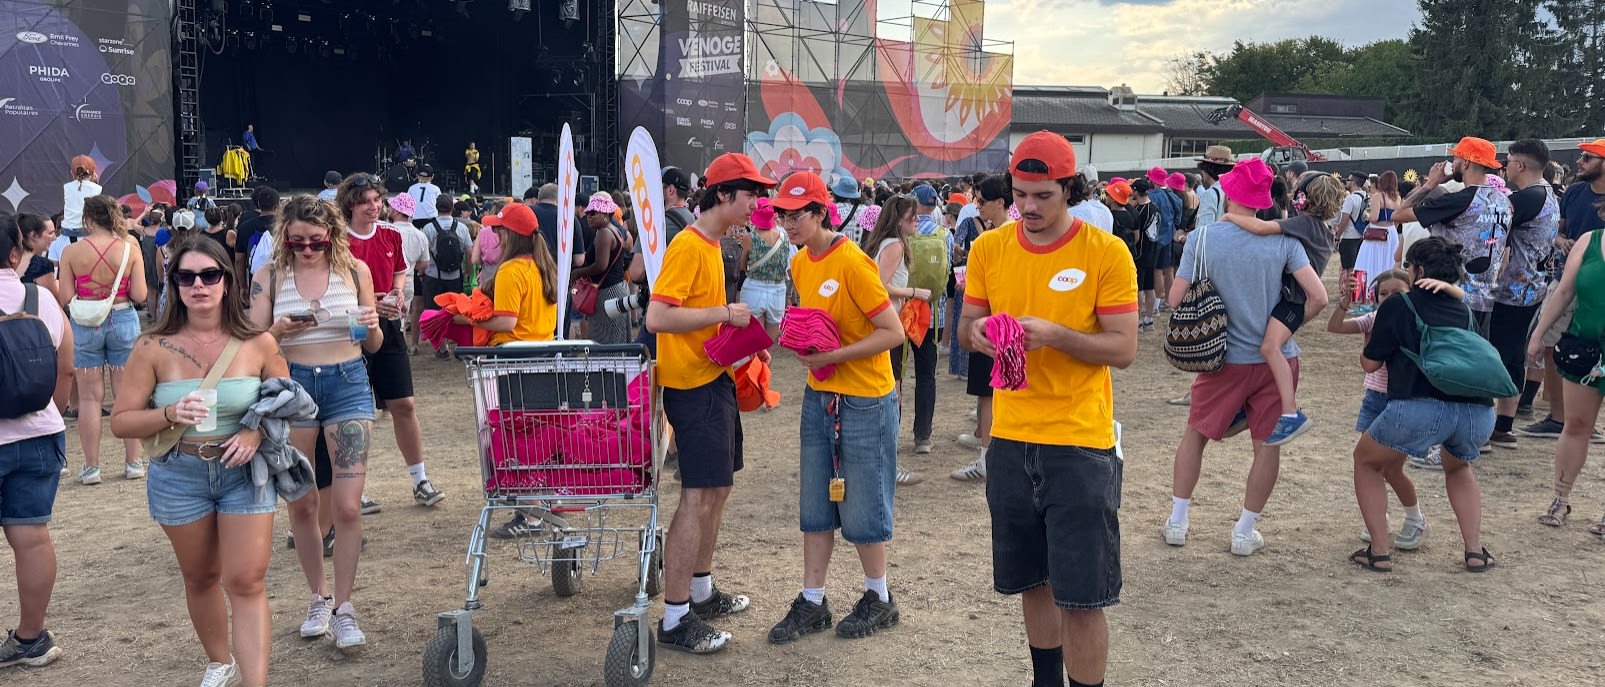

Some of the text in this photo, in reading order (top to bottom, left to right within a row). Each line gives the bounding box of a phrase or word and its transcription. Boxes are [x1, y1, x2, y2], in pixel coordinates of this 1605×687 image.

[687, 0, 737, 21] RAIFFEISEN
[65, 34, 79, 43] Frey
[108, 46, 135, 56] Sunrise
[678, 35, 741, 57] VENOGE
[29, 65, 70, 78] PHIDA
[689, 59, 731, 73] FESTIVAL
[101, 72, 136, 86] QoQa
[676, 97, 693, 107] coop
[1057, 276, 1078, 285] coop
